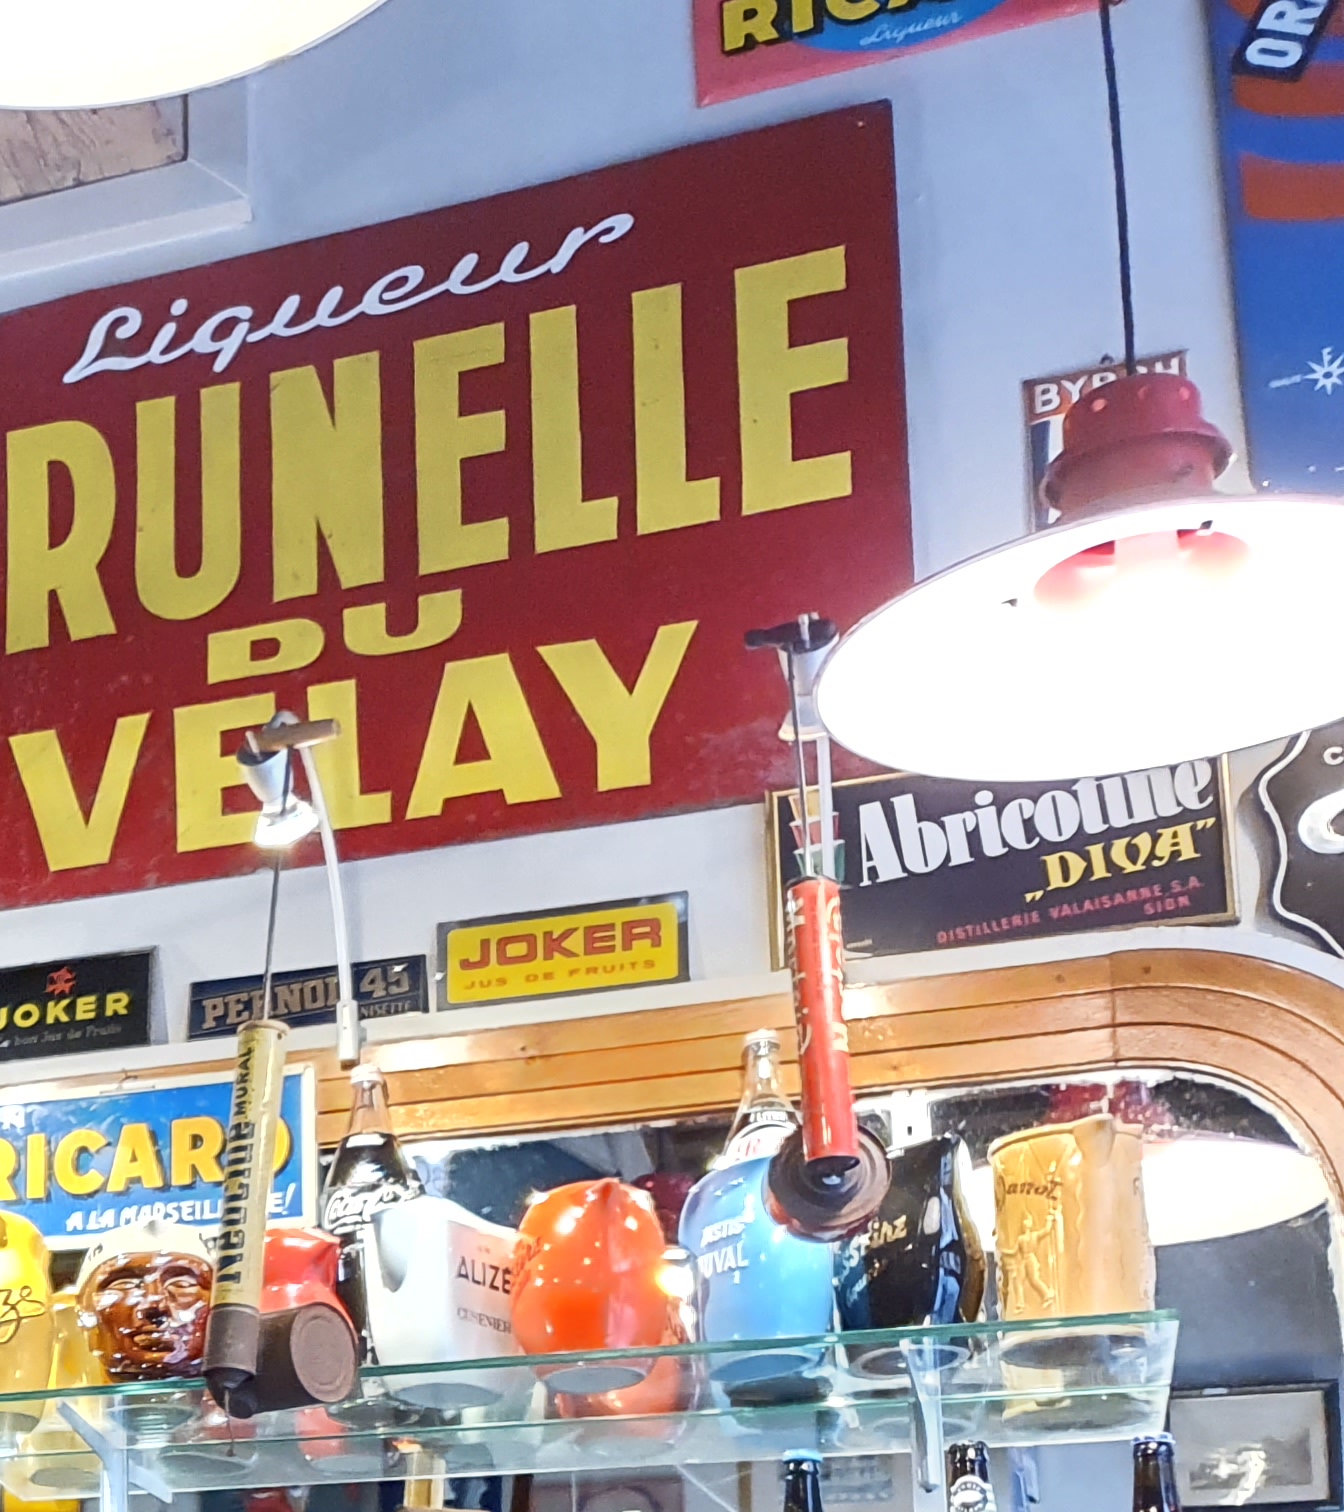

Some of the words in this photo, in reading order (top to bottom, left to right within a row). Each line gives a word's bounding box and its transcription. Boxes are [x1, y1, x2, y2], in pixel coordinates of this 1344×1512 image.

[63, 211, 634, 383] Liqueur
[208, 588, 463, 684] DU
[10, 619, 699, 872] VELAY
[937, 908, 1040, 944] DISTILLERIE
[1049, 883, 1163, 919] VALAISANNE
[1144, 896, 1190, 915] SION
[460, 918, 662, 971] JOKER
[361, 966, 410, 998] 45
[465, 976, 507, 990] JUS
[524, 970, 555, 984] DE
[568, 958, 655, 979] FRUITS
